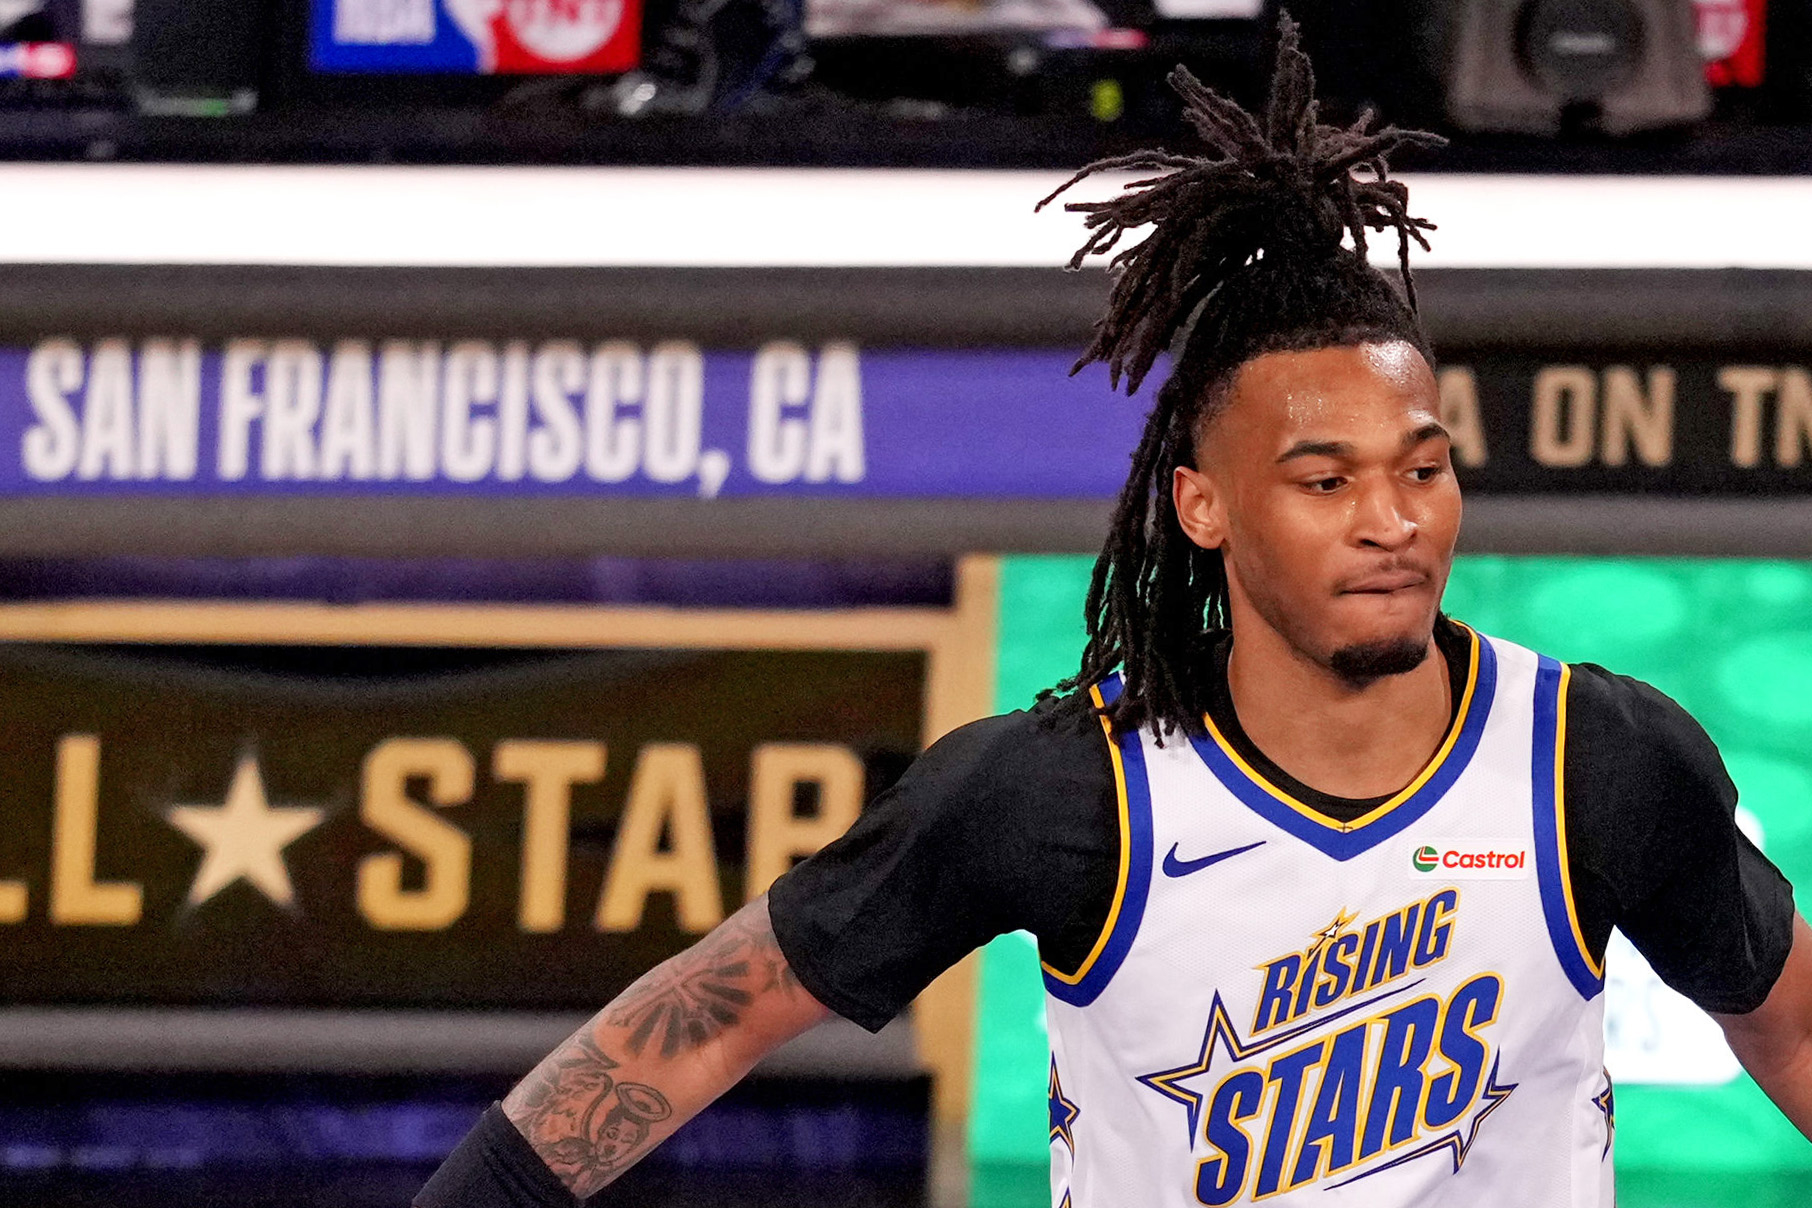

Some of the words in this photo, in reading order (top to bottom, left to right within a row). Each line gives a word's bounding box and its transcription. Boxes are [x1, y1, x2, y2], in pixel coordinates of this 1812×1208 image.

[21, 340, 199, 482] SAN
[218, 338, 731, 499] FRANCISCO,
[746, 340, 866, 484] CA
[1530, 364, 1678, 468] ON
[356, 737, 866, 933] STAR
[1442, 850, 1526, 869] Castrol
[1249, 887, 1461, 1037] RISING
[1193, 971, 1505, 1208] STARS
